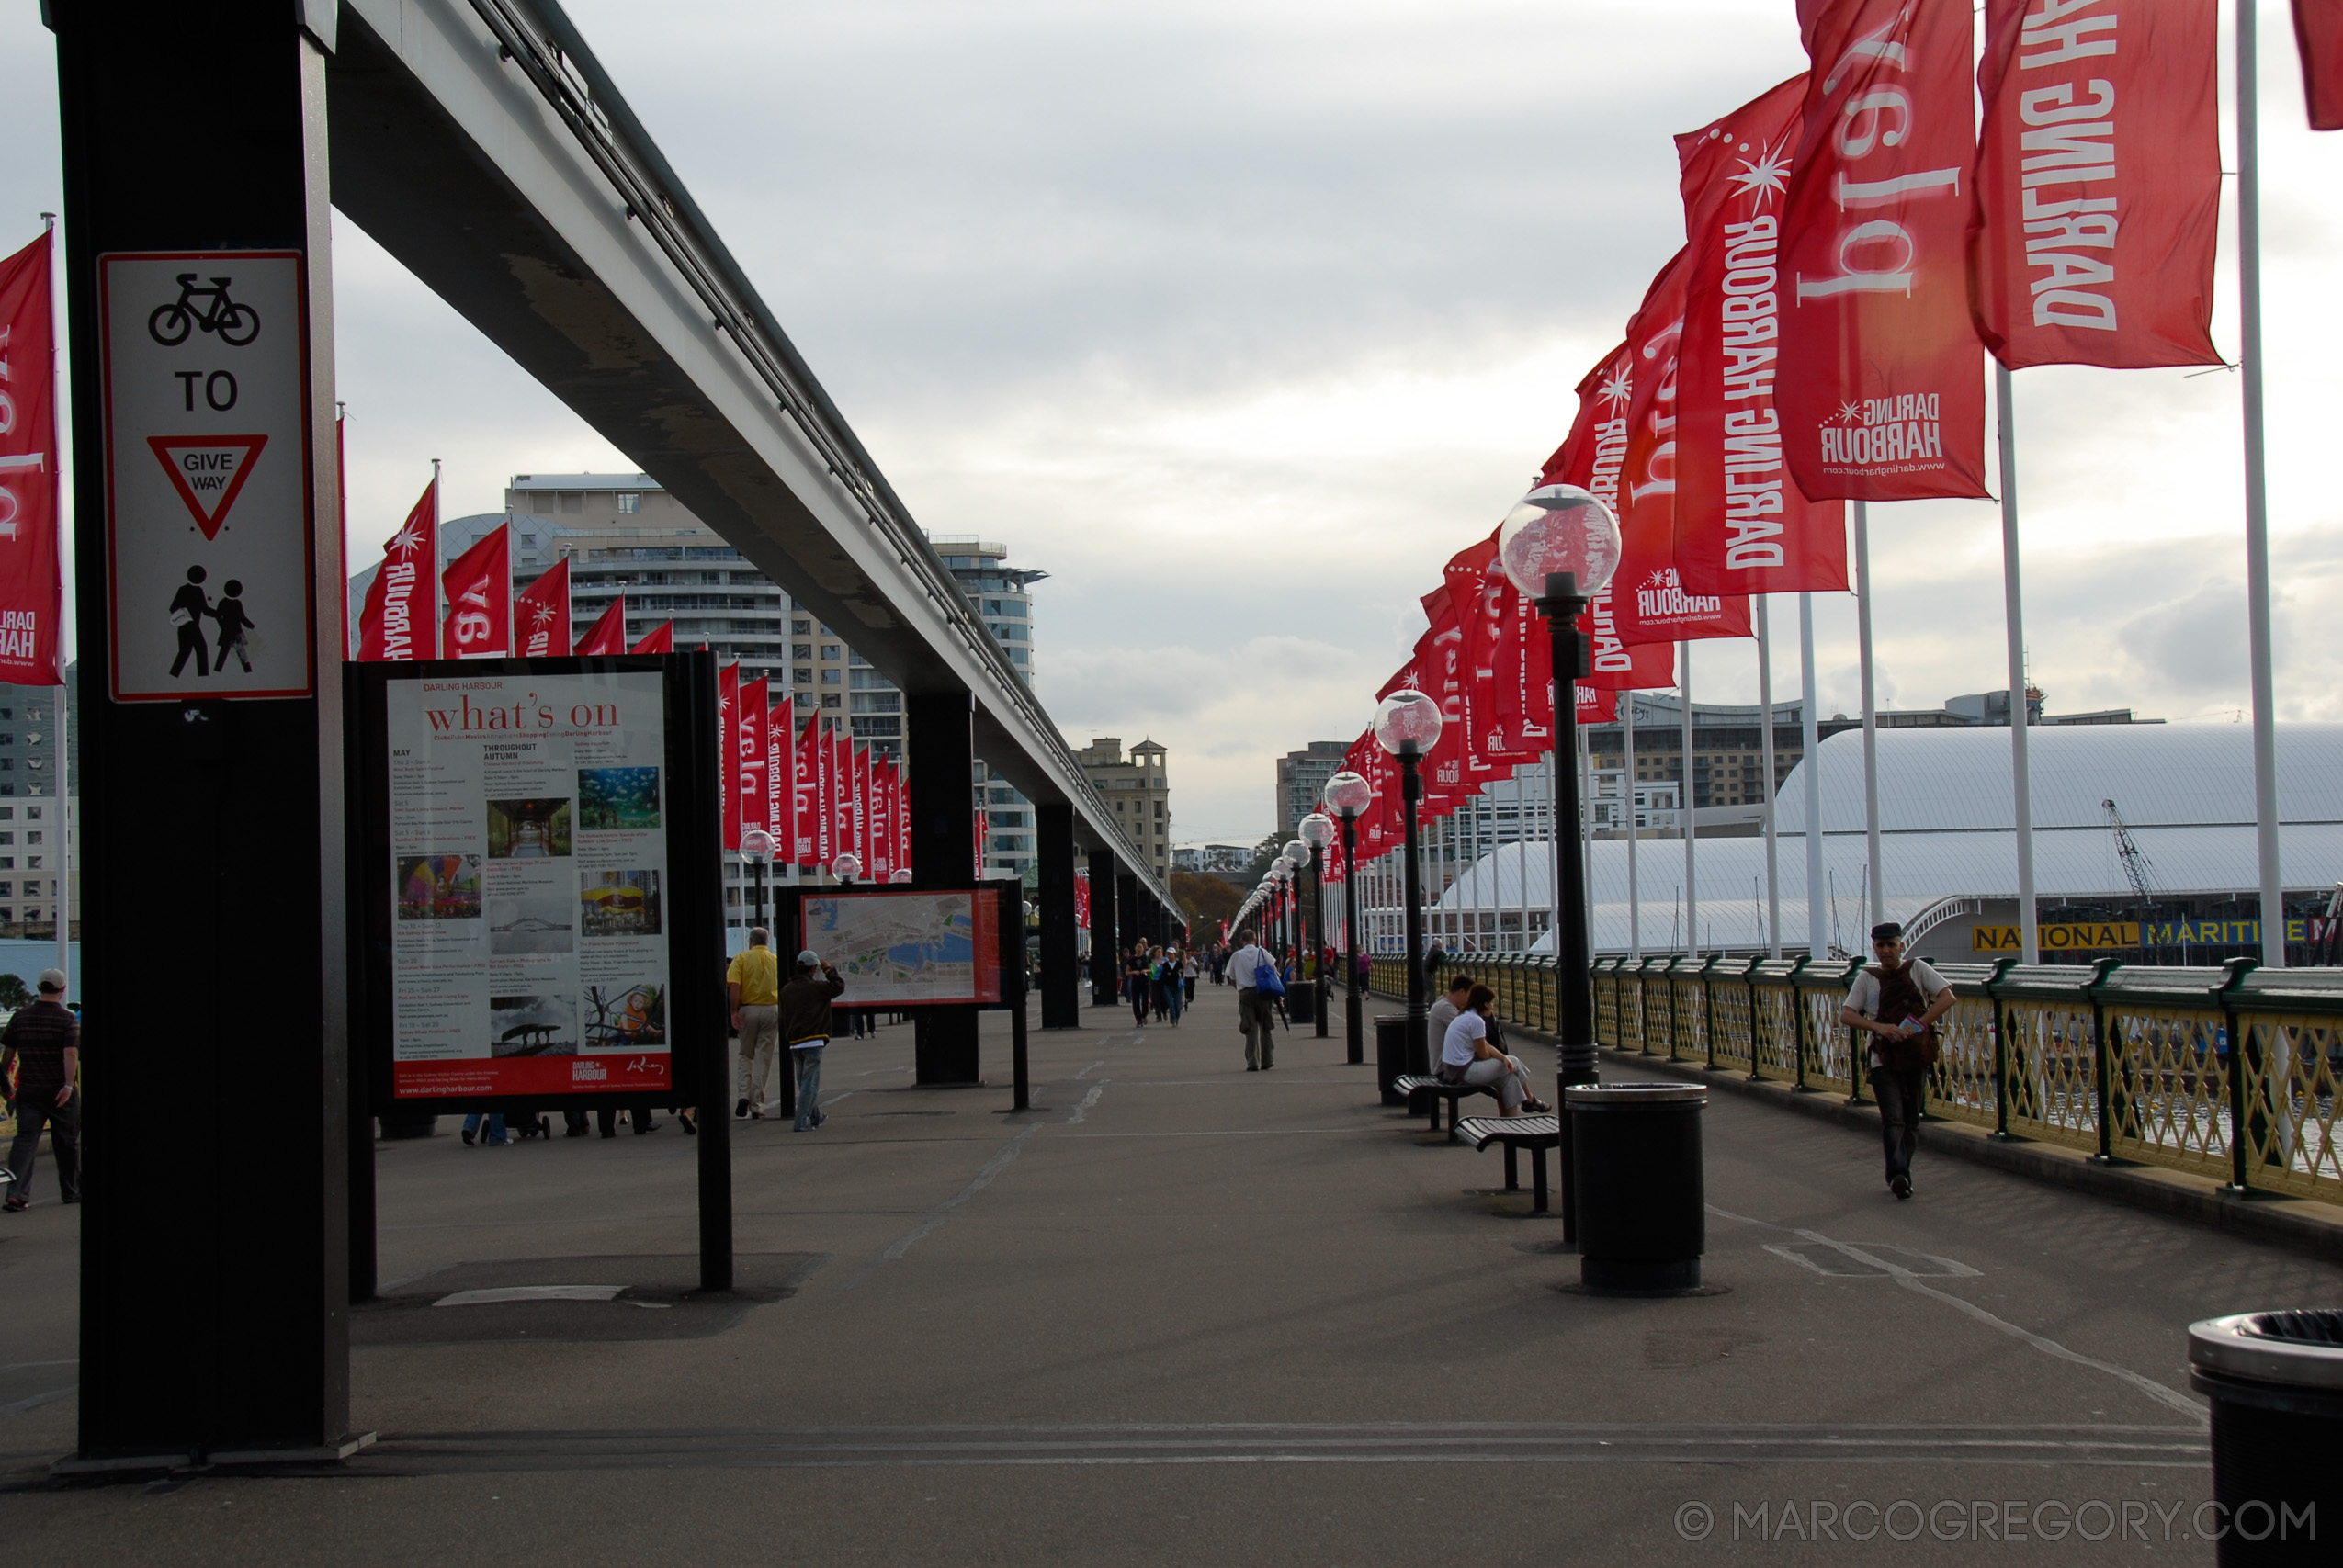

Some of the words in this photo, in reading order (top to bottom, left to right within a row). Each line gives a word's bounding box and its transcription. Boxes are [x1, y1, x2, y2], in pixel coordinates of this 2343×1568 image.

[175, 370, 238, 412] TO
[184, 453, 232, 470] GIVE
[191, 476, 226, 490] WAY
[424, 683, 460, 692] DARLING
[462, 682, 503, 691] HARBOUR
[424, 692, 554, 732] what's
[571, 703, 620, 728] on
[393, 749, 411, 757] MAY
[483, 743, 537, 751] THROUGHOUT
[484, 752, 518, 761] AUTUMN
[1976, 925, 2138, 949] NAIONAL
[2147, 920, 2305, 945] MARITIE
[572, 1061, 594, 1070] DARLING
[572, 1068, 607, 1081] HARBOUR
[399, 1083, 492, 1095] www.darlingharbour.com
